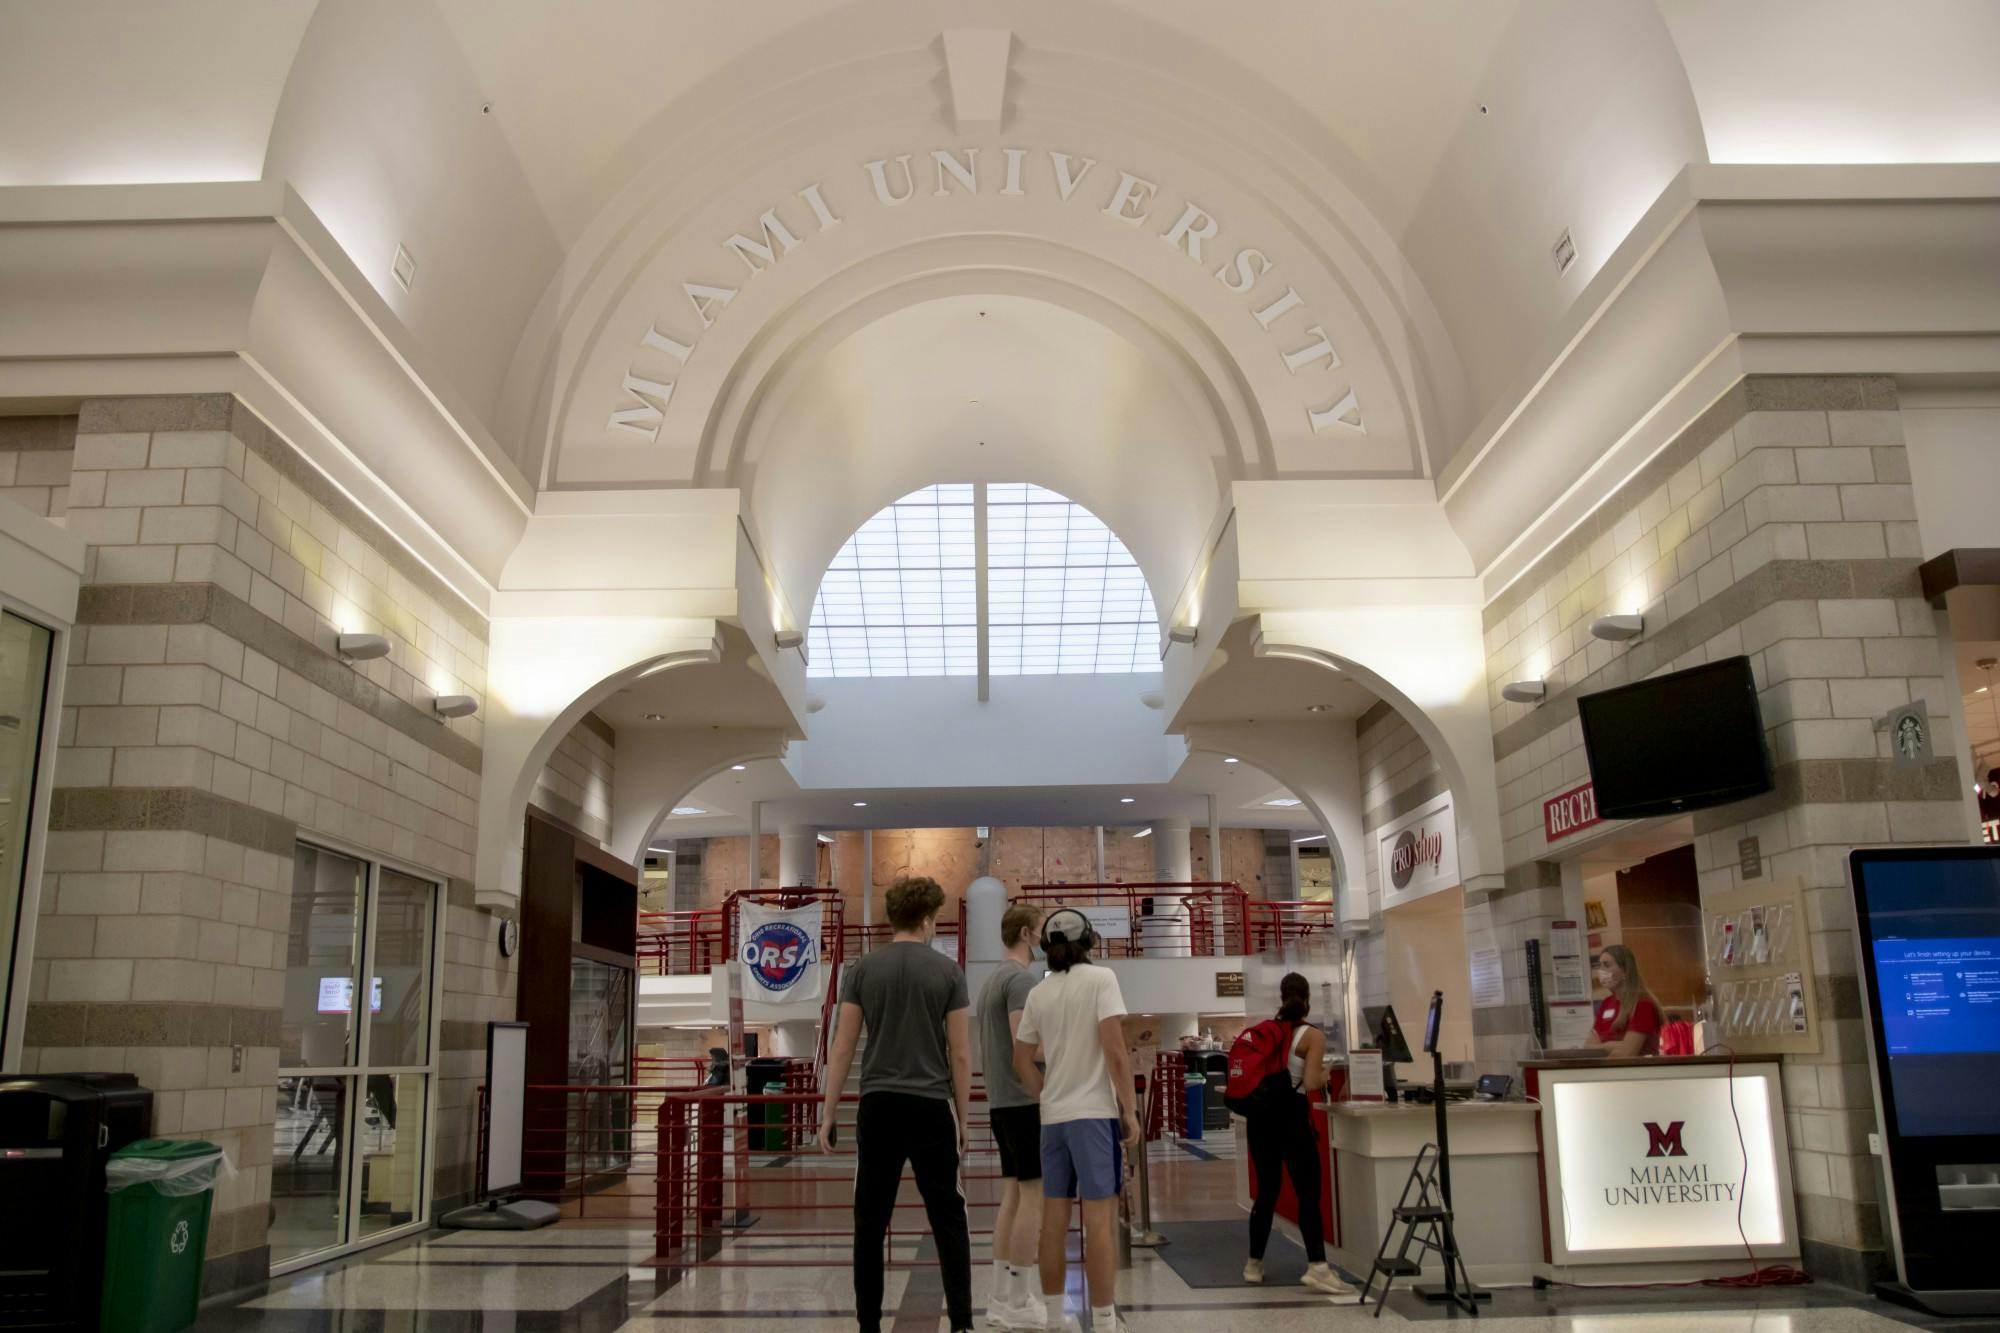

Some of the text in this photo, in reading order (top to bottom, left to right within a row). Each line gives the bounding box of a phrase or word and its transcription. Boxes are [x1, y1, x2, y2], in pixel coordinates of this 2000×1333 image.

[606, 148, 1367, 443] MIAMI UNIVERSITY
[1393, 827, 1442, 873] PRO shop
[741, 938, 817, 968] ORSA
[1643, 1120, 1688, 1157] M
[1630, 1164, 1709, 1184] MIAMI
[1604, 1183, 1737, 1206] UNIVERSITY
